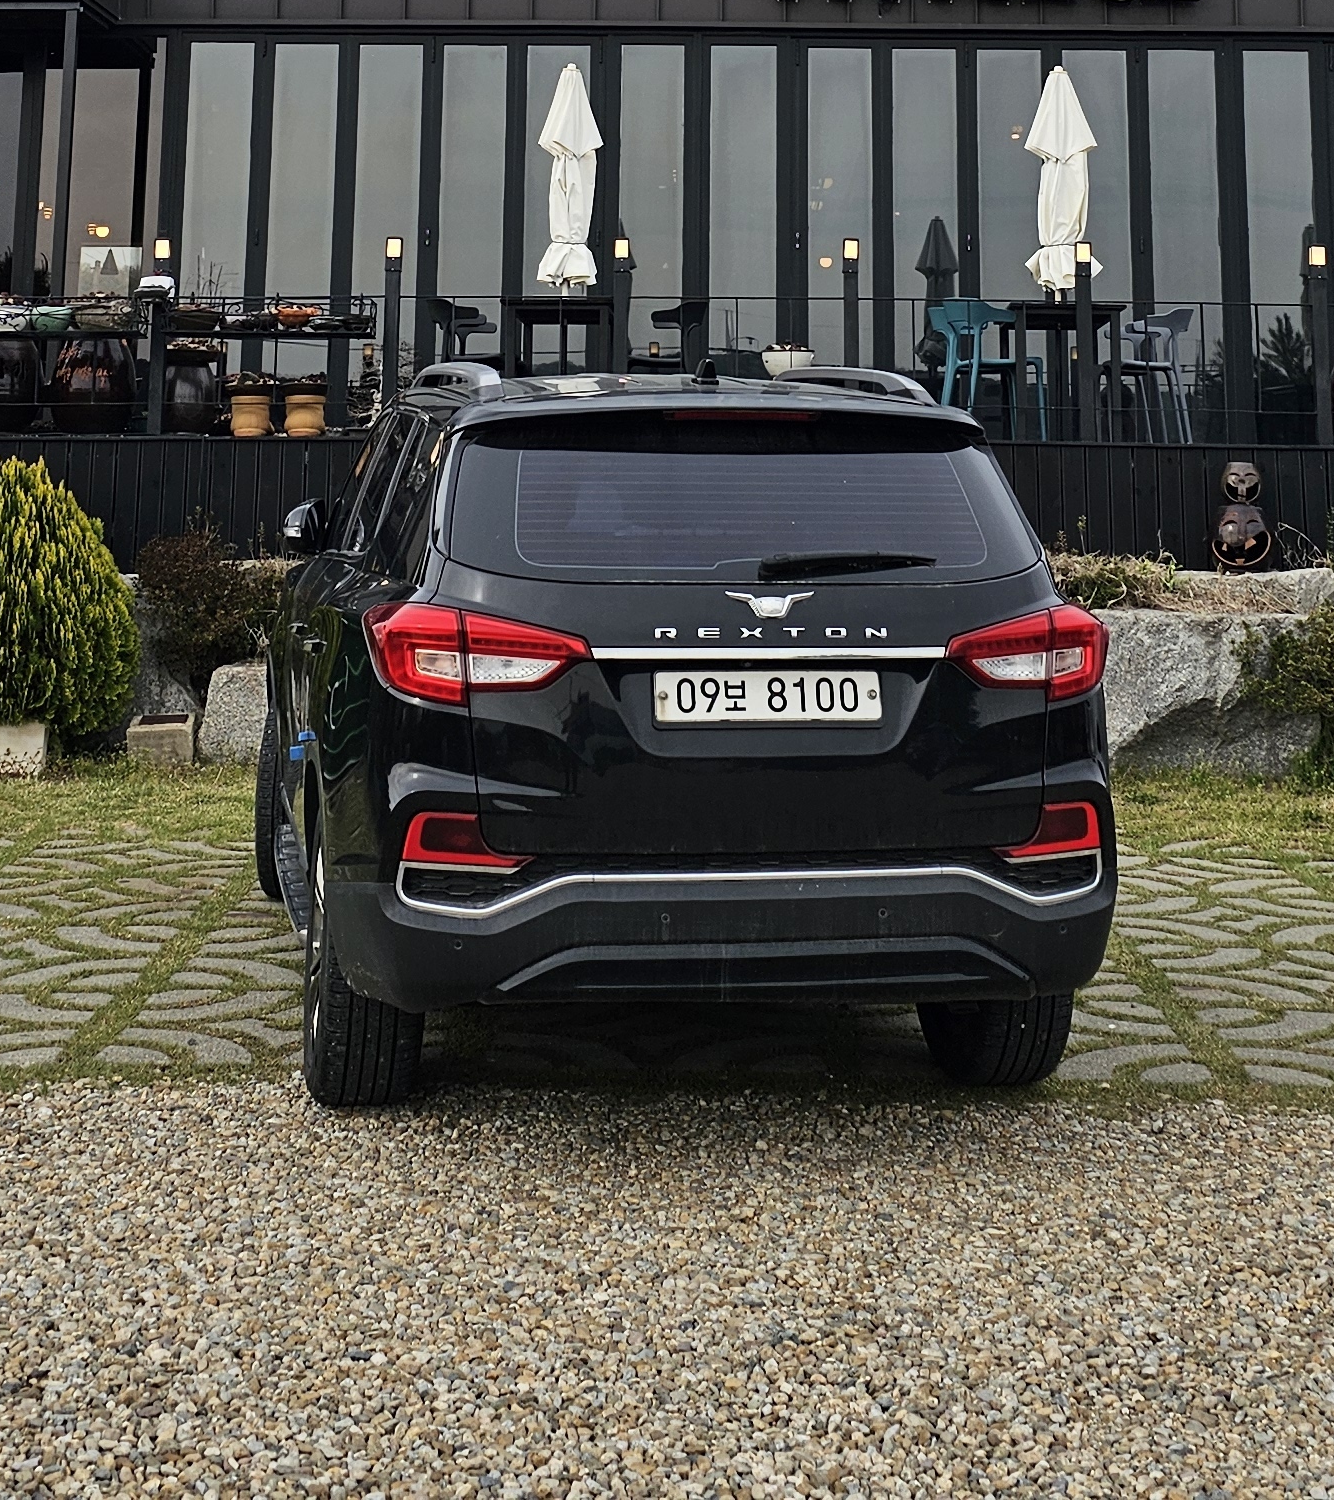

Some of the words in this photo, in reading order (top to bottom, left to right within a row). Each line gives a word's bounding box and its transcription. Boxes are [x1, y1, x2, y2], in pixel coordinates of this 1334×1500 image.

[654, 627, 888, 639] REXTON
[676, 677, 747, 713] 09보
[766, 676, 859, 713] 8100
